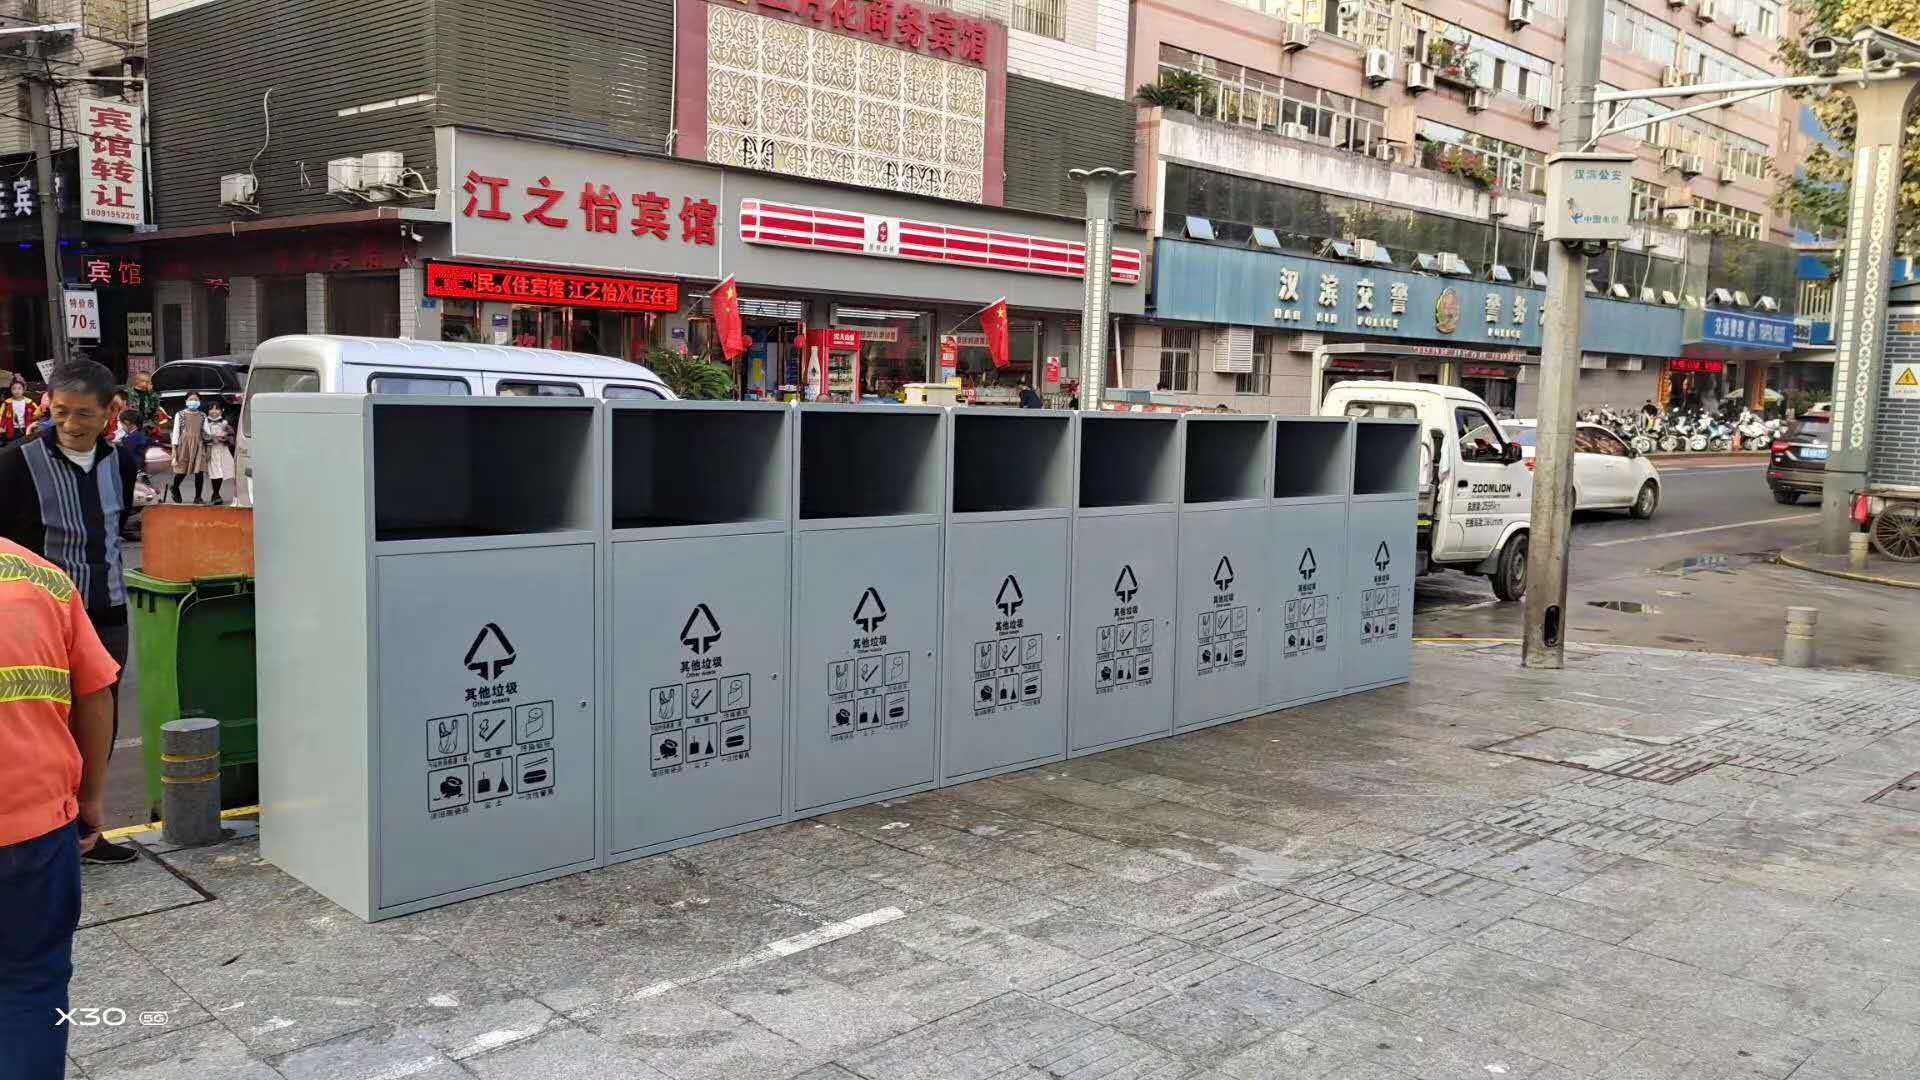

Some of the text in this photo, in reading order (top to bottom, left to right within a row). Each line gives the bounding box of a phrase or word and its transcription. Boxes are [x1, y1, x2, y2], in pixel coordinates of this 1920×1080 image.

[88, 105, 135, 209] 宾馆转让
[463, 169, 718, 246] 江之怡宾馆
[87, 259, 143, 285] 宾馆
[1279, 267, 1409, 313] 汉滨交警
[1357, 316, 1399, 329] POLICE
[1472, 484, 1512, 493] ZOOMLION
[853, 635, 887, 649] 其他垃圾
[679, 656, 723, 673] 其他垃圾
[464, 681, 519, 702] 其他垃圾
[472, 700, 490, 708] Other
